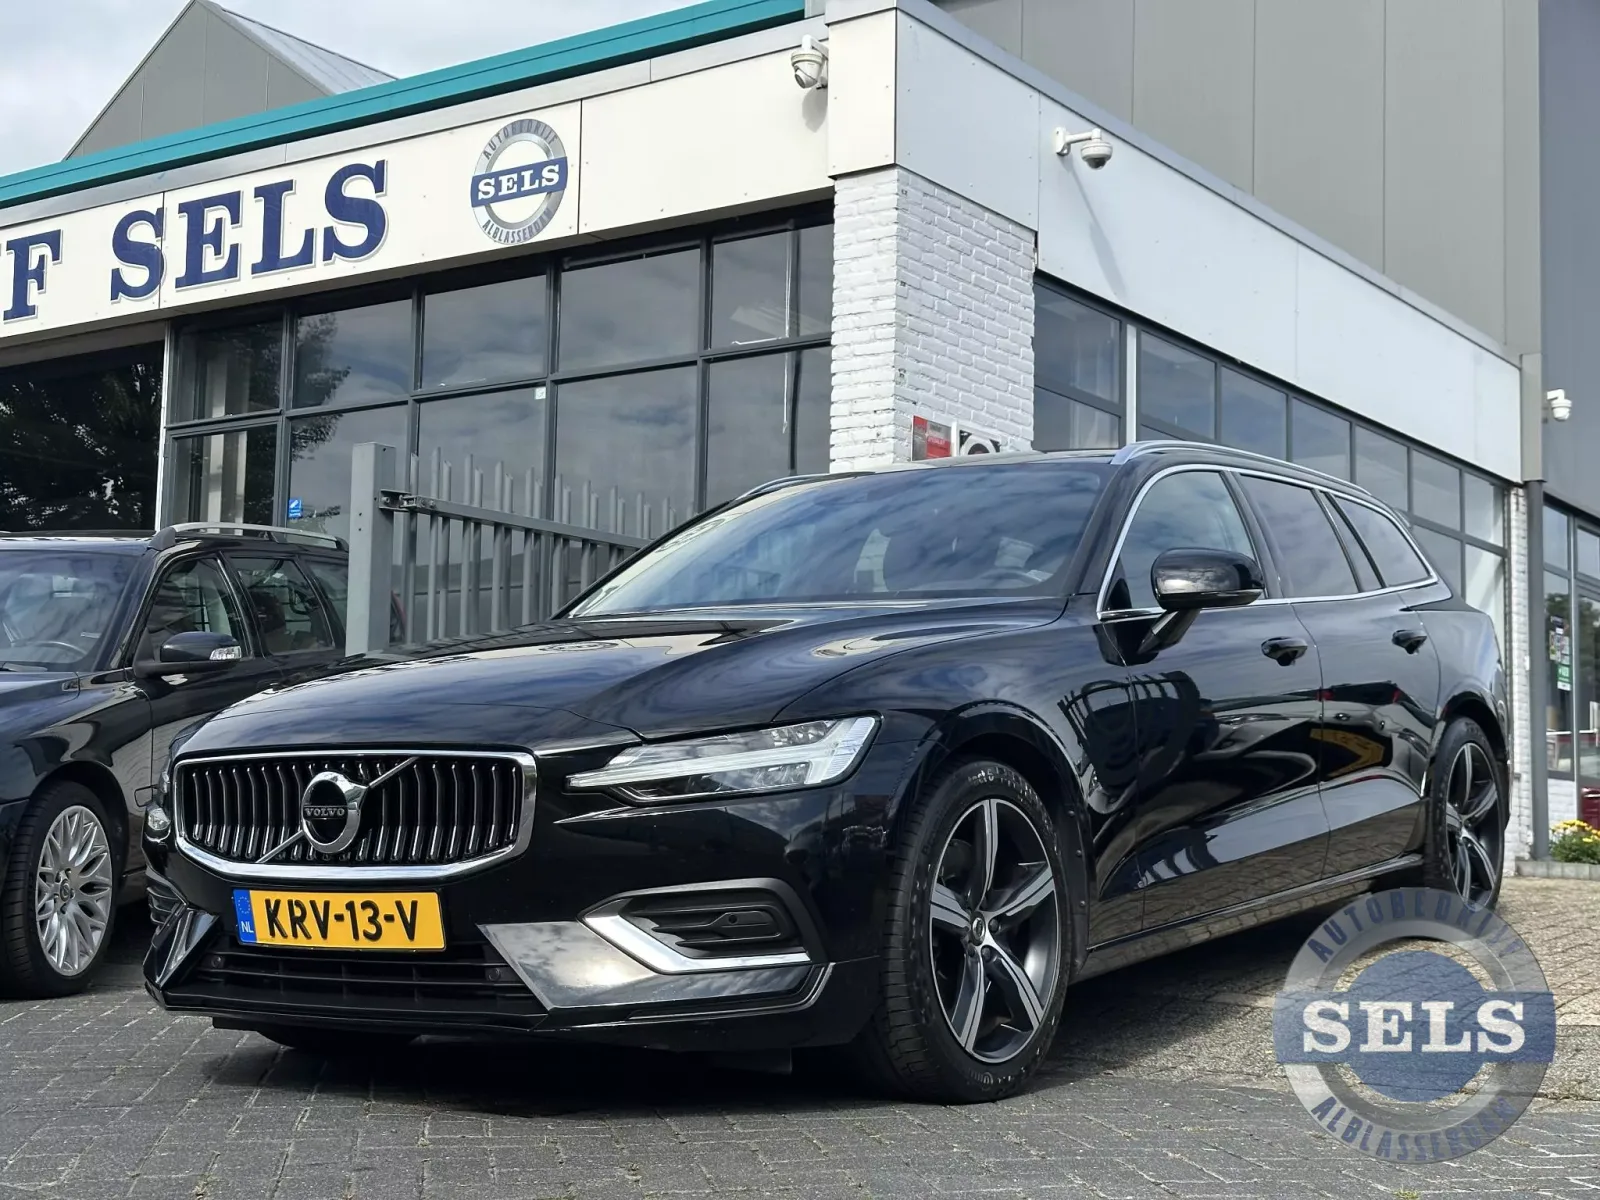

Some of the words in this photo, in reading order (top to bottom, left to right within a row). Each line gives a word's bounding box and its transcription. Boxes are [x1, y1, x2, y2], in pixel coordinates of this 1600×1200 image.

[478, 164, 560, 200] SELS
[110, 160, 387, 301] SELS
[304, 807, 346, 817] VOLVO
[241, 921, 254, 933] NL
[264, 898, 419, 942] KRV-13-V
